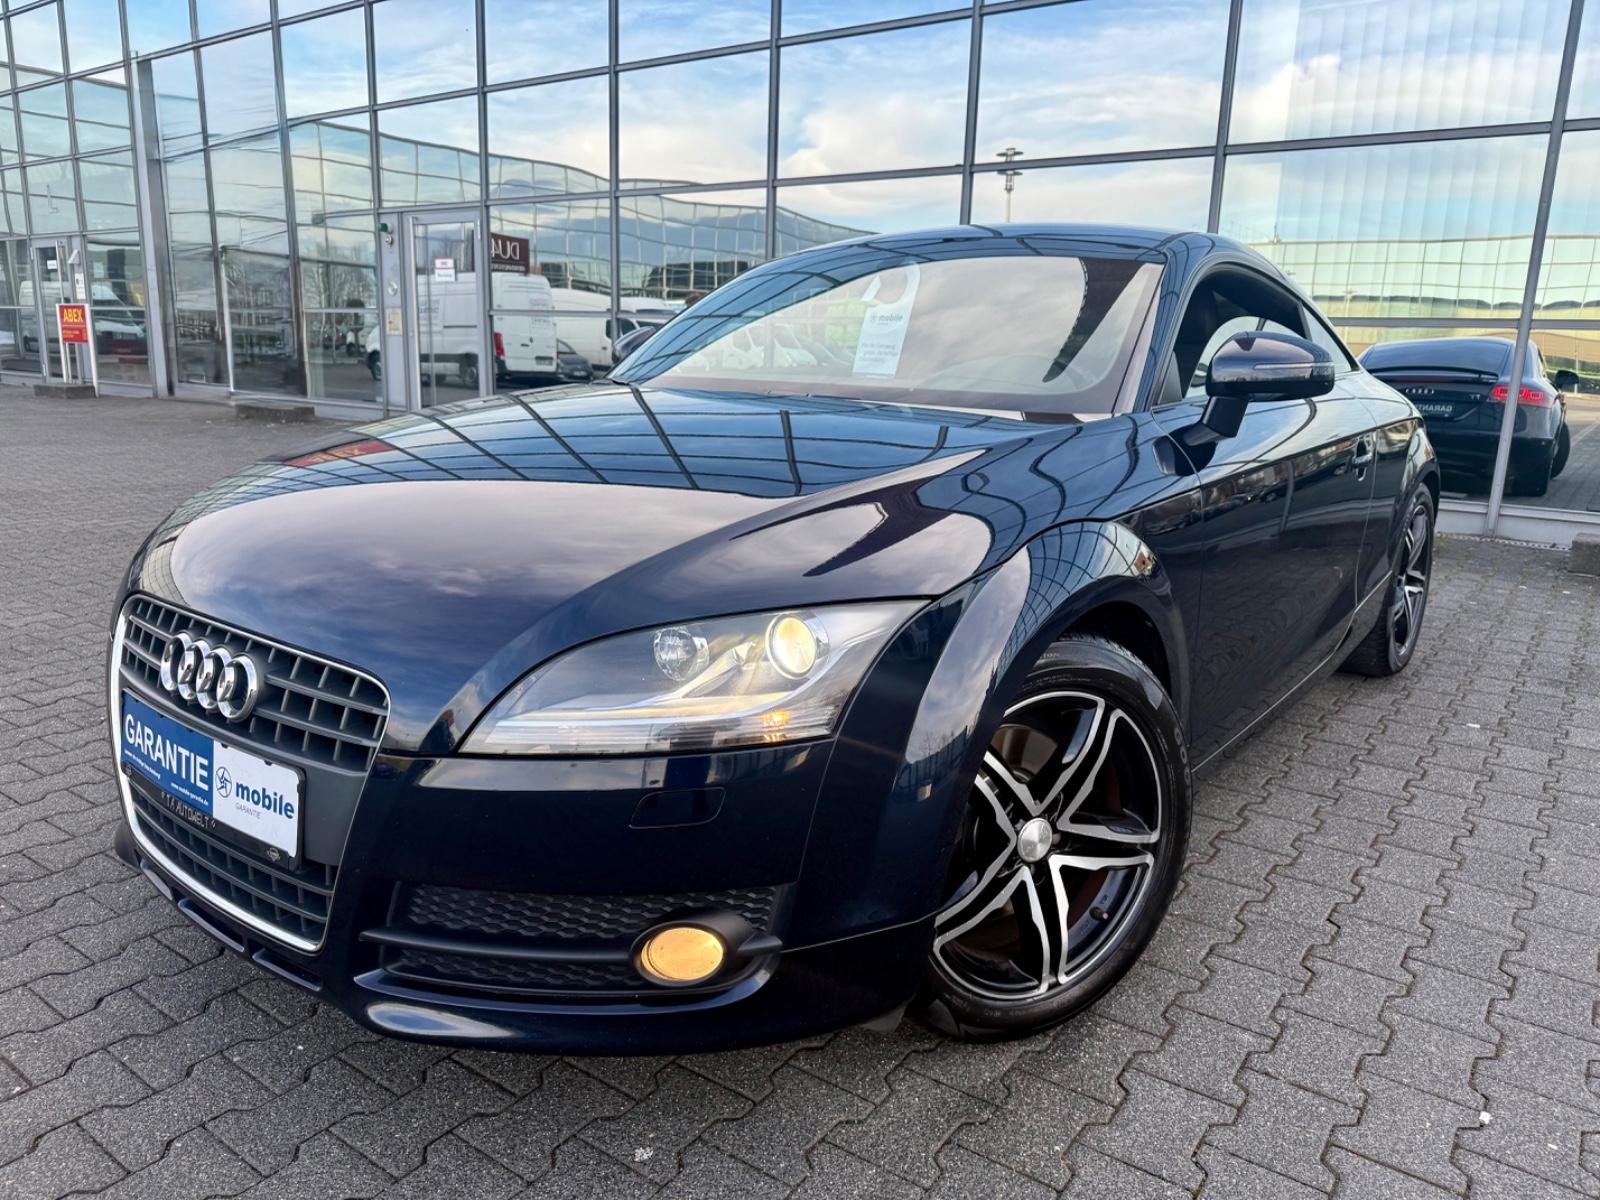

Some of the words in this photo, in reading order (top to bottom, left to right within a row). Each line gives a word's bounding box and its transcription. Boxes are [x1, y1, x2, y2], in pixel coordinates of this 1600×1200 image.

[63, 308, 84, 323] ABEX
[125, 713, 209, 791] GARANTIE
[235, 781, 295, 820] mobile
[235, 802, 261, 820] GARANTIE
